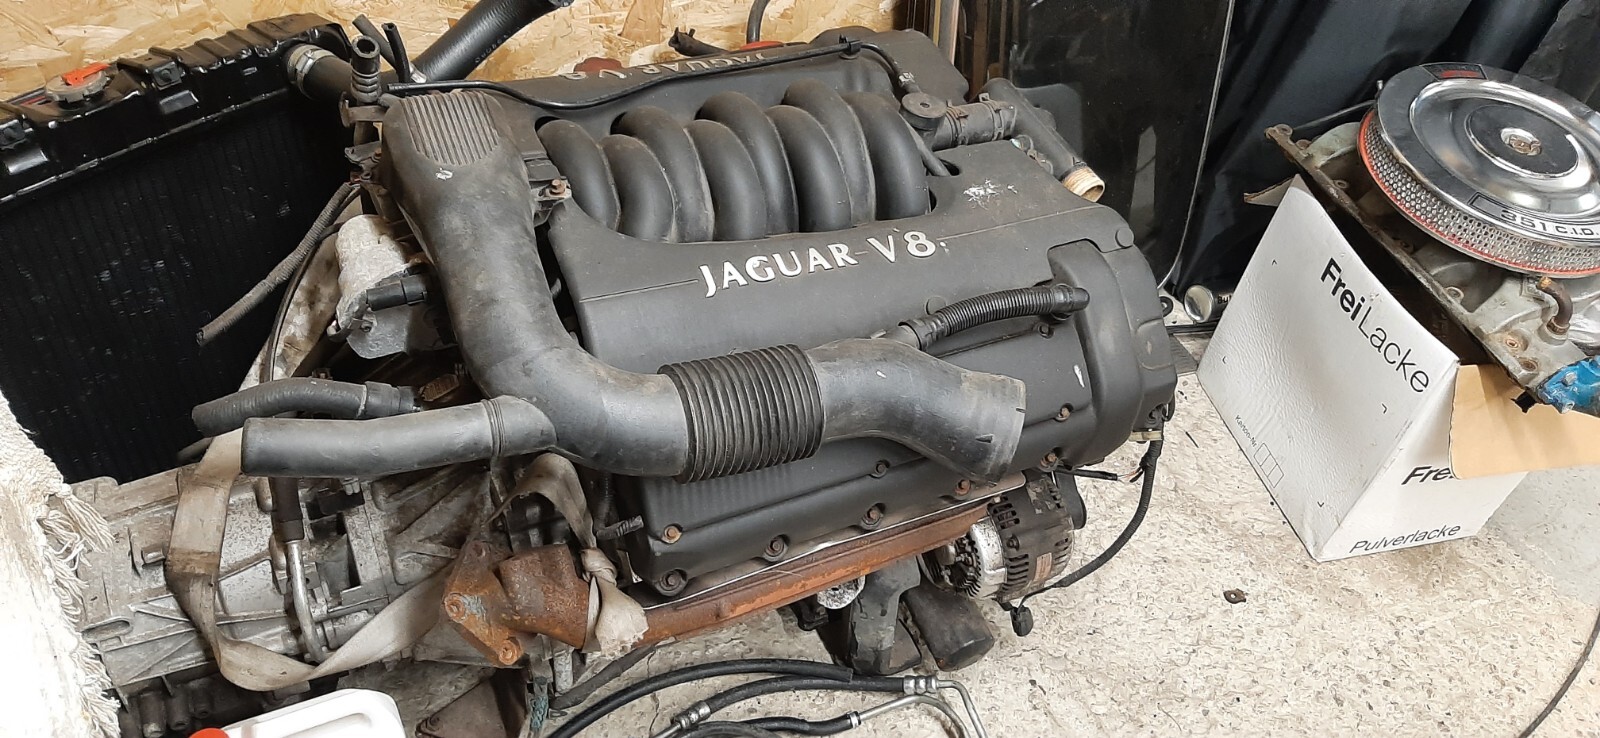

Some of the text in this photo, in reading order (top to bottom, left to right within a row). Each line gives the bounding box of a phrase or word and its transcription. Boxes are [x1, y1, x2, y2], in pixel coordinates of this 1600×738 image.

[1501, 209, 1547, 232] 351
[700, 231, 936, 298] JAGUAR V8
[1320, 257, 1430, 393] FreiLacke
[1401, 465, 1454, 486] Fre
[1349, 525, 1461, 554] Pulverlacke
